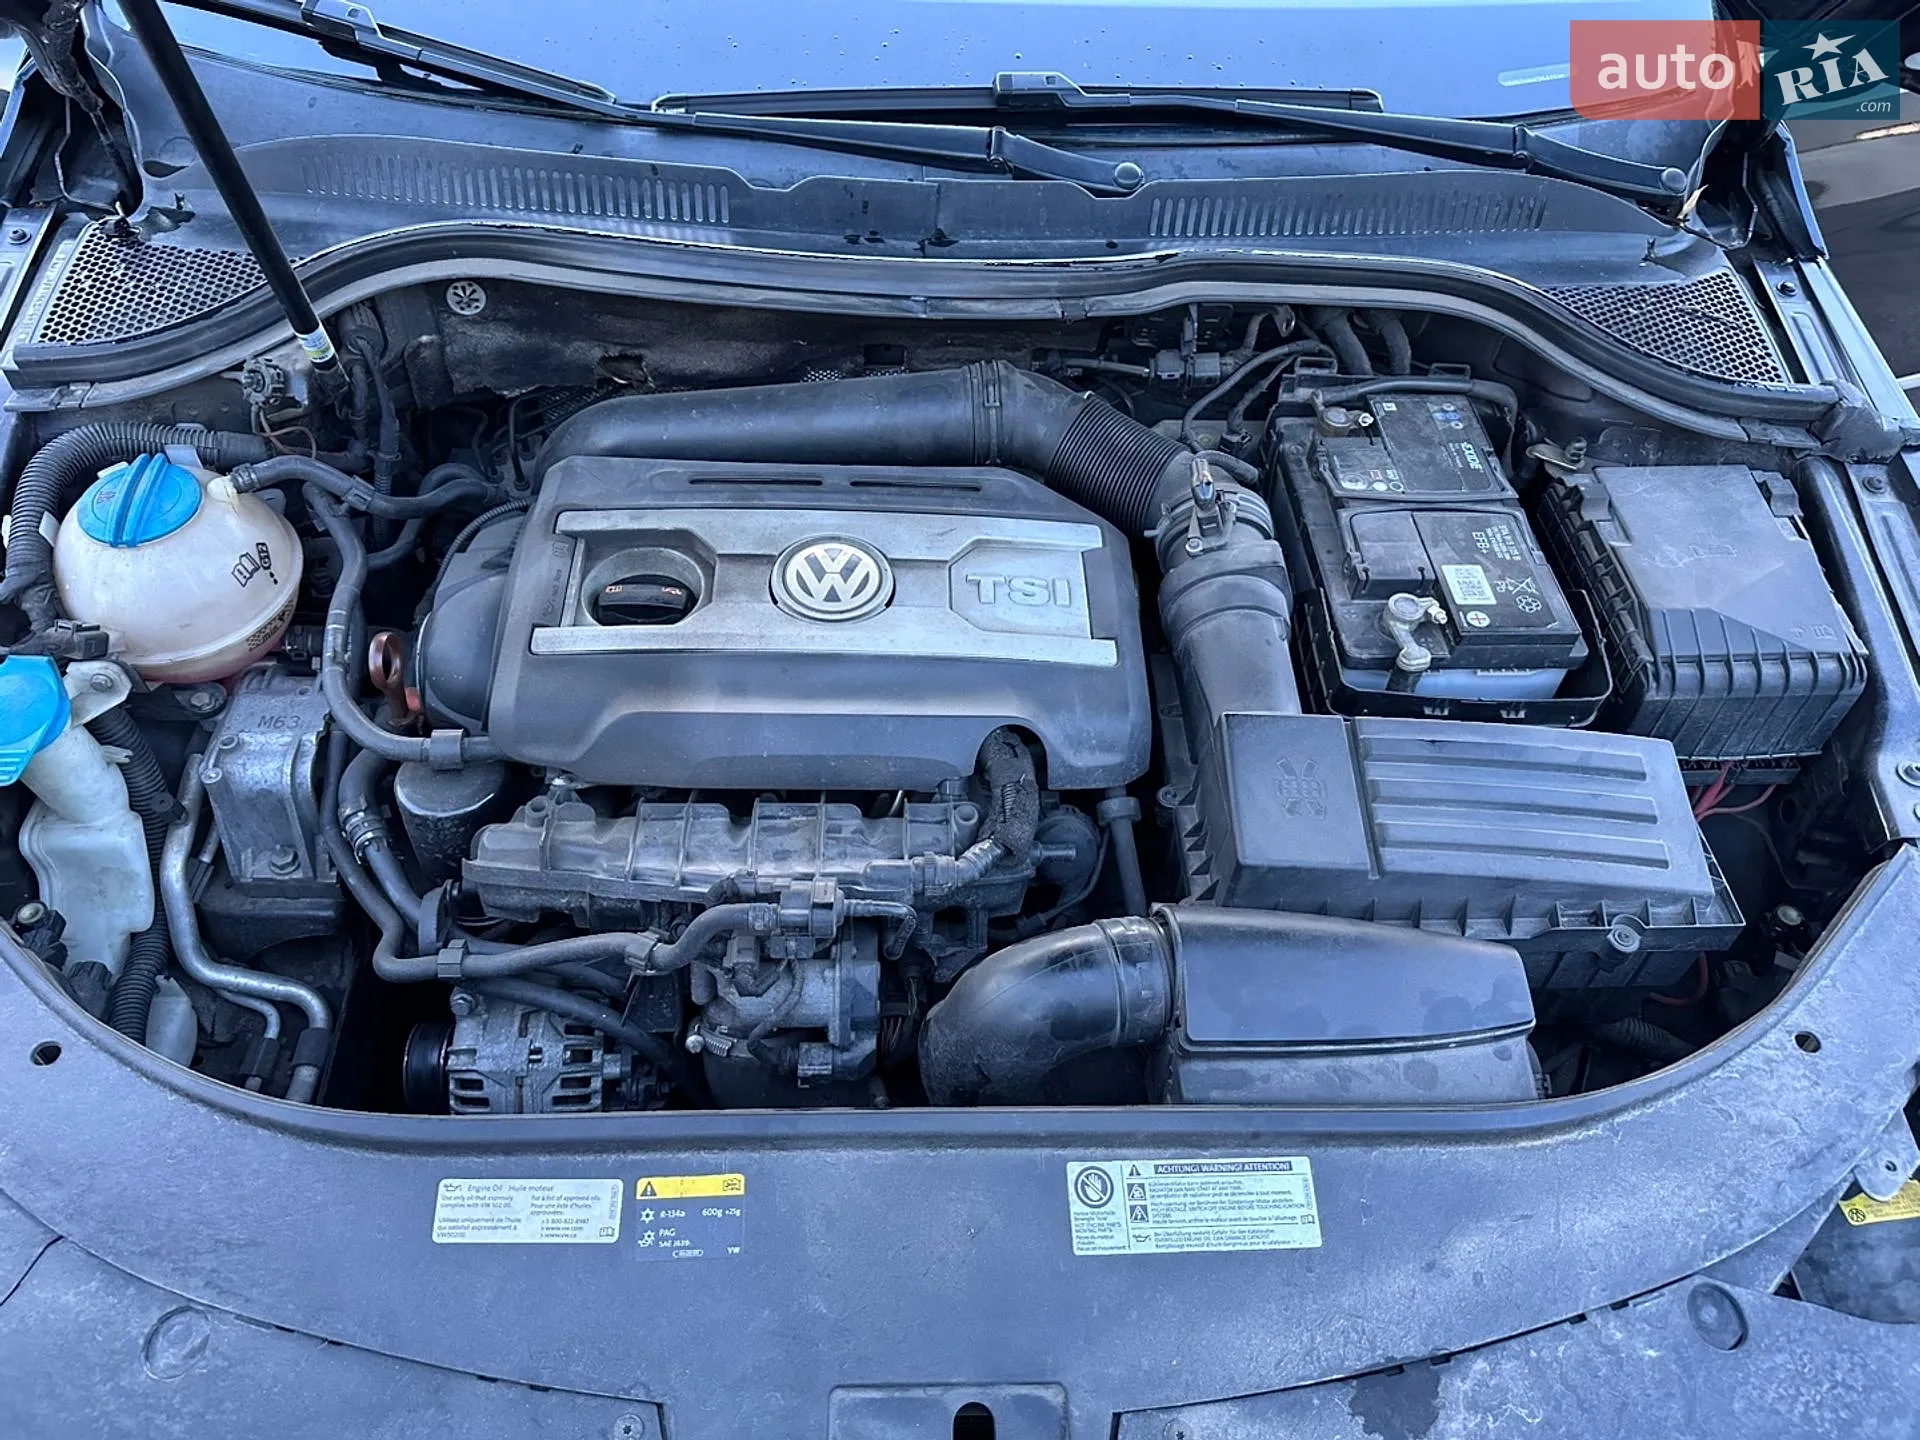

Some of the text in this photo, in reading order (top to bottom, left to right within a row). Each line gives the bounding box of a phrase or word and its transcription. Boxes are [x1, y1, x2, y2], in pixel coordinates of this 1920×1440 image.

[1460, 442, 1483, 470] EXIDE
[966, 575, 1071, 607] TSI
[257, 715, 300, 729] M63
[1157, 1161, 1291, 1174] ACHTUNG! WARNING! ATTENTION!
[702, 1208, 723, 1218] 600g
[659, 1228, 676, 1237] PAG
[727, 1246, 741, 1254] VW
